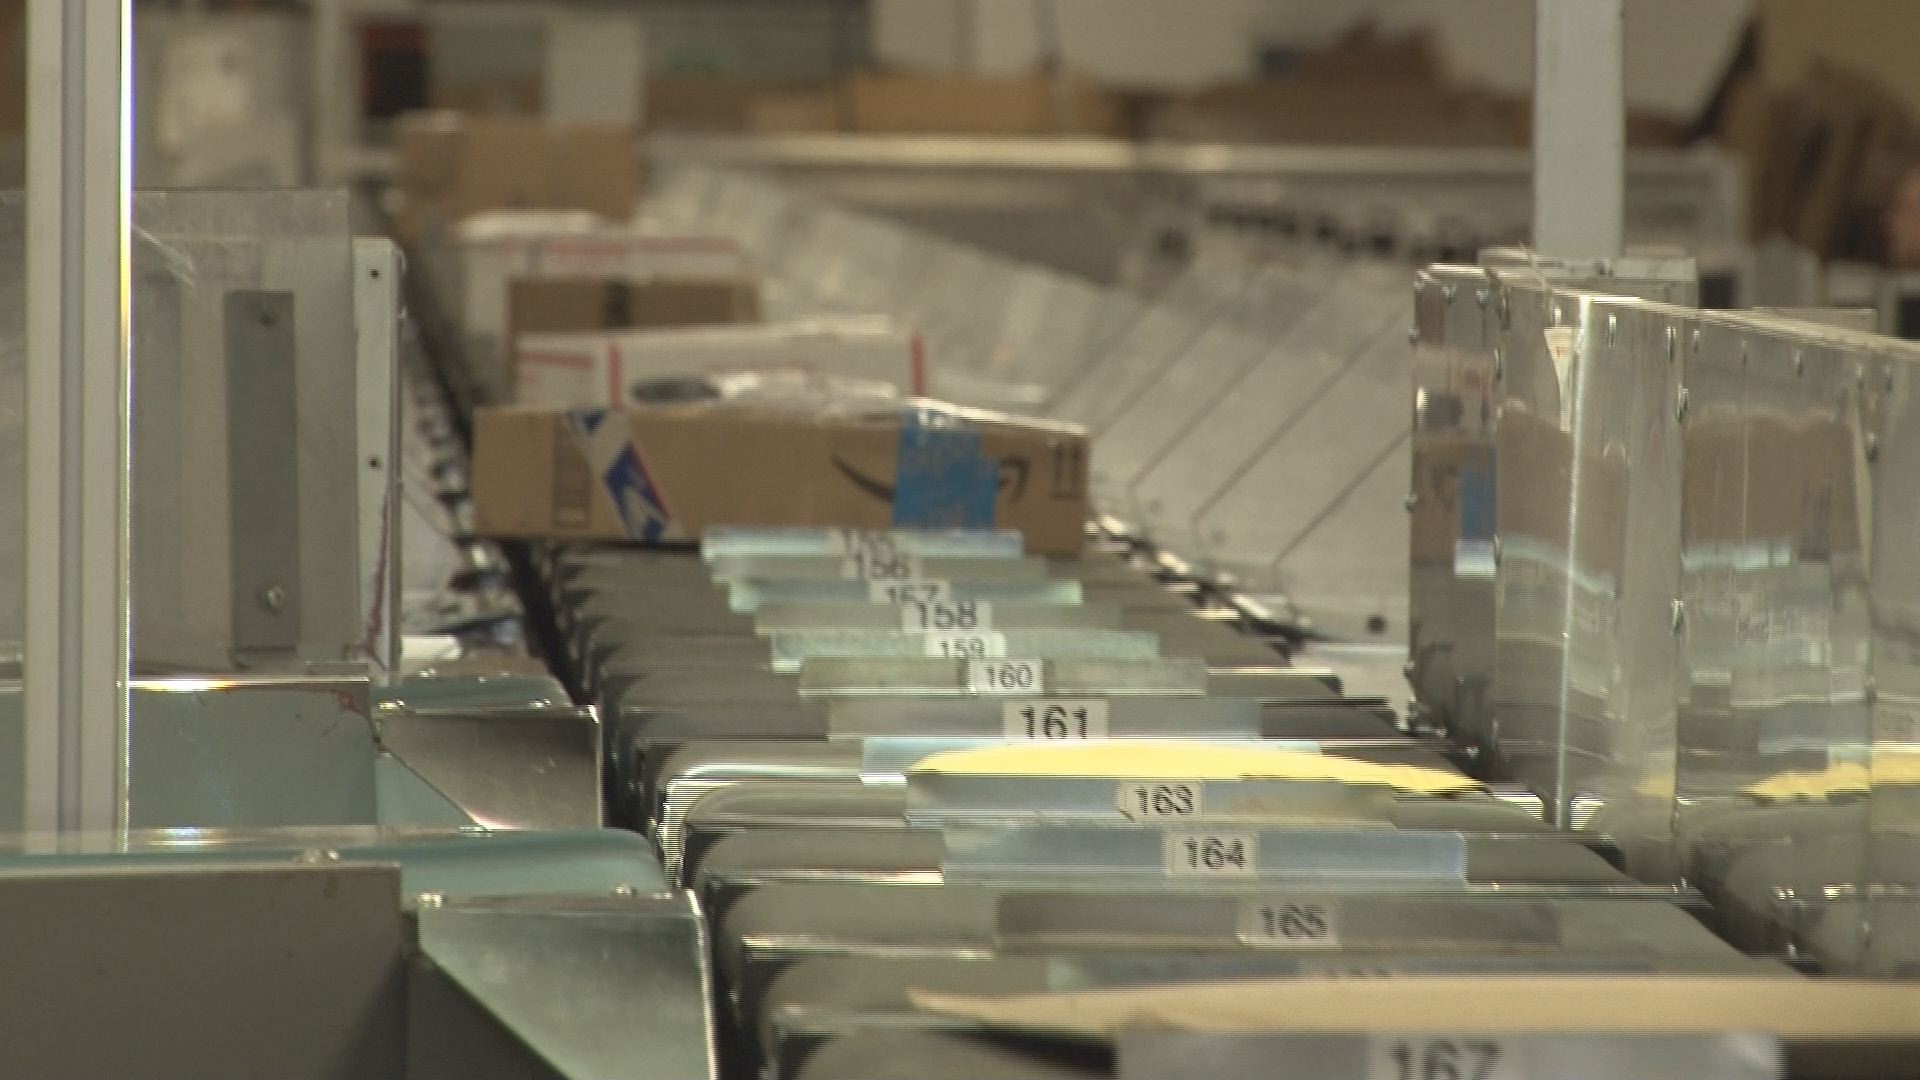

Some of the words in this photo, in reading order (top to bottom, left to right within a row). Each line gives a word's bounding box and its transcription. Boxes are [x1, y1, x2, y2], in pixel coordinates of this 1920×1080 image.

[884, 584, 940, 602] 157
[914, 602, 978, 630] 158
[940, 637, 985, 658] 159
[984, 664, 1033, 688] 160
[1019, 705, 1088, 739] 161
[1135, 784, 1194, 815] 163
[1184, 836, 1247, 870] 164
[1258, 904, 1328, 940] 165
[1388, 1039, 1503, 1080] 167
